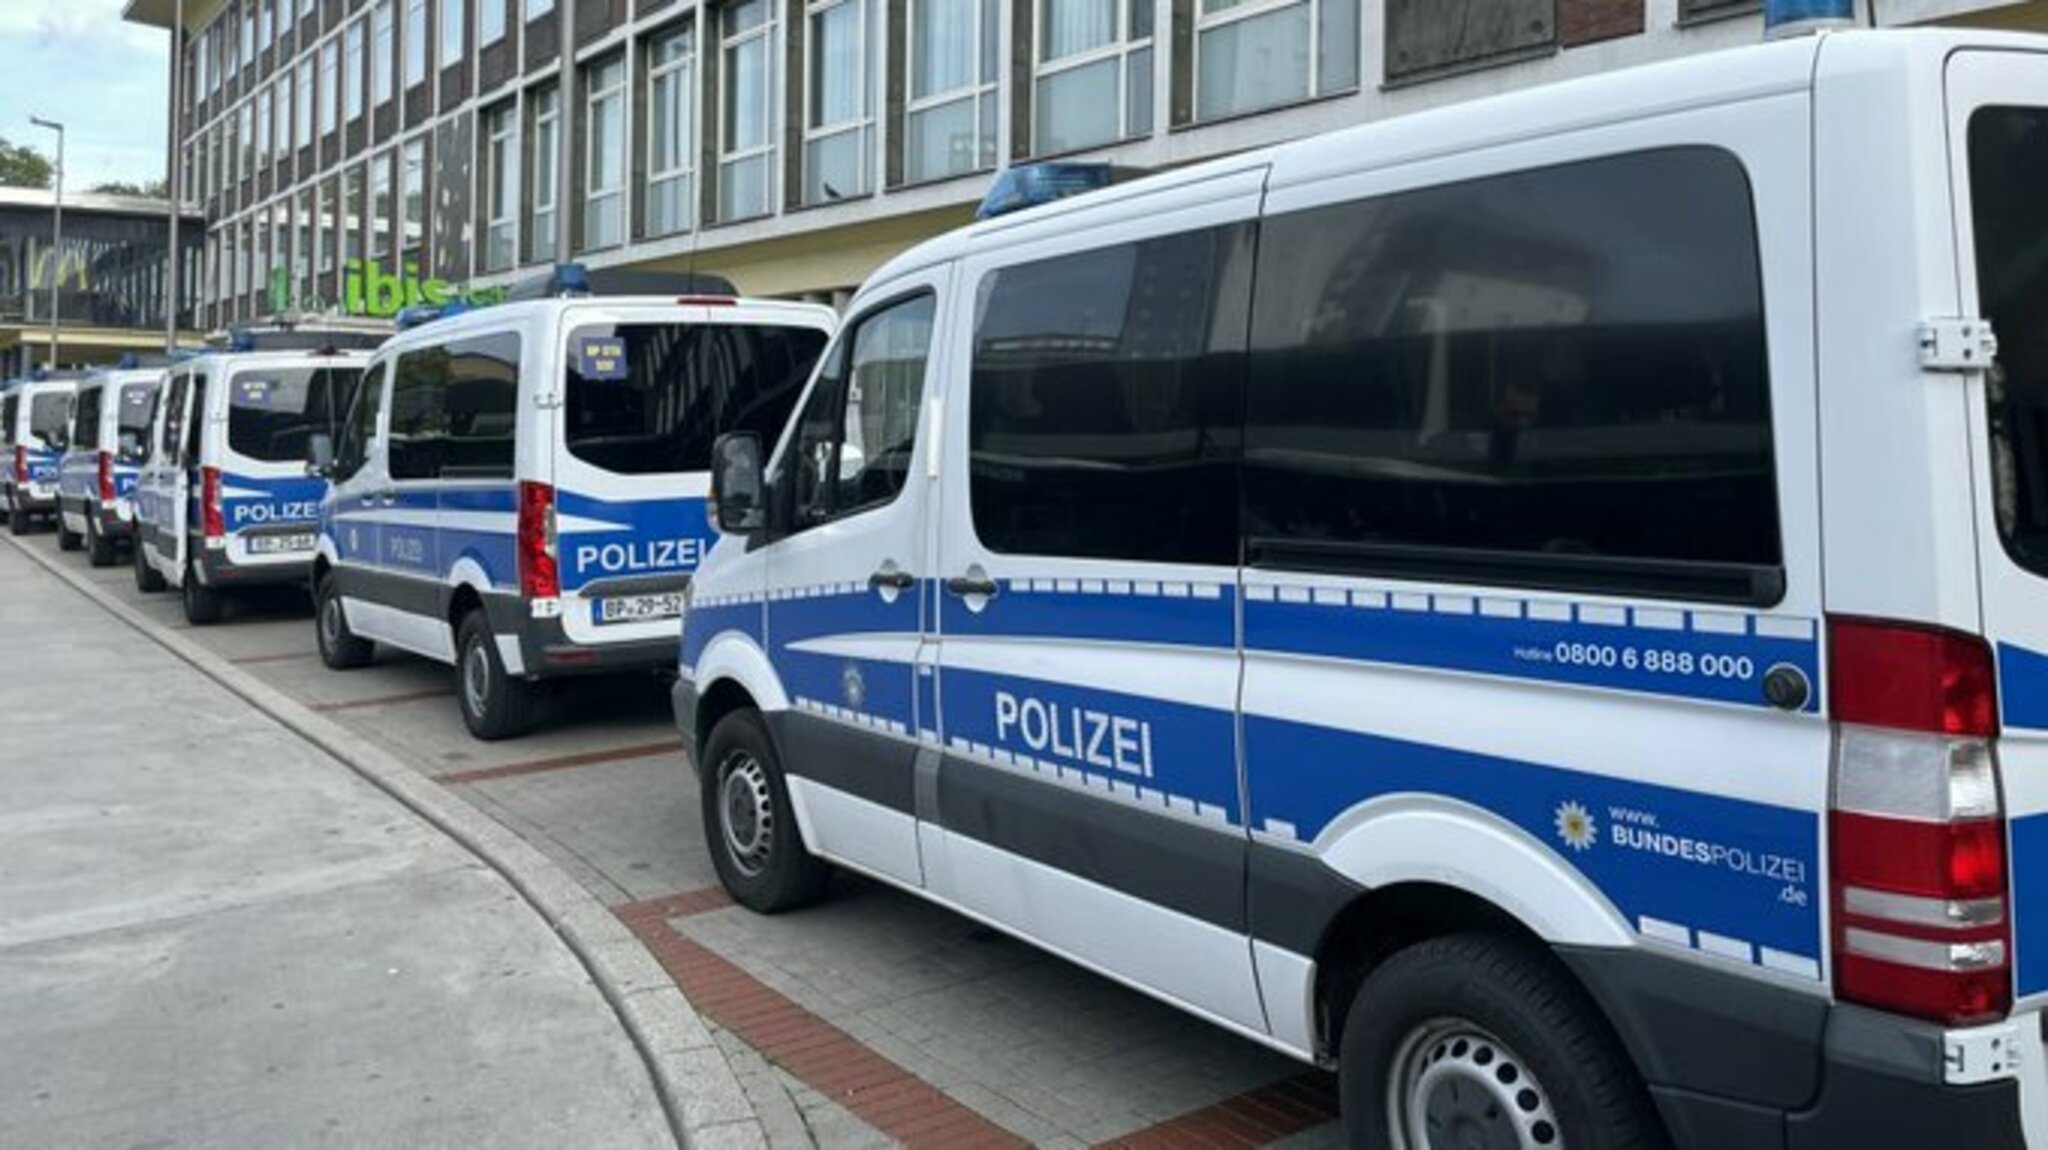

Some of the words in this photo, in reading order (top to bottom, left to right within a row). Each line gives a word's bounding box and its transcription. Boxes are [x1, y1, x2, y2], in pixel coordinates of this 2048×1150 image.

[345, 257, 453, 315] ibis
[234, 502, 320, 522] POLIZE
[1514, 646, 1552, 662] Hotline
[1555, 642, 1617, 667] 0800
[1621, 647, 1639, 669] 6
[1644, 649, 1694, 675] 888
[1700, 653, 1754, 680] 000
[995, 691, 1153, 778] POLIZEI
[1608, 806, 1660, 829] www.
[1611, 824, 1806, 883] BUNDESPOLIZEI
[1777, 885, 1808, 907] .de
